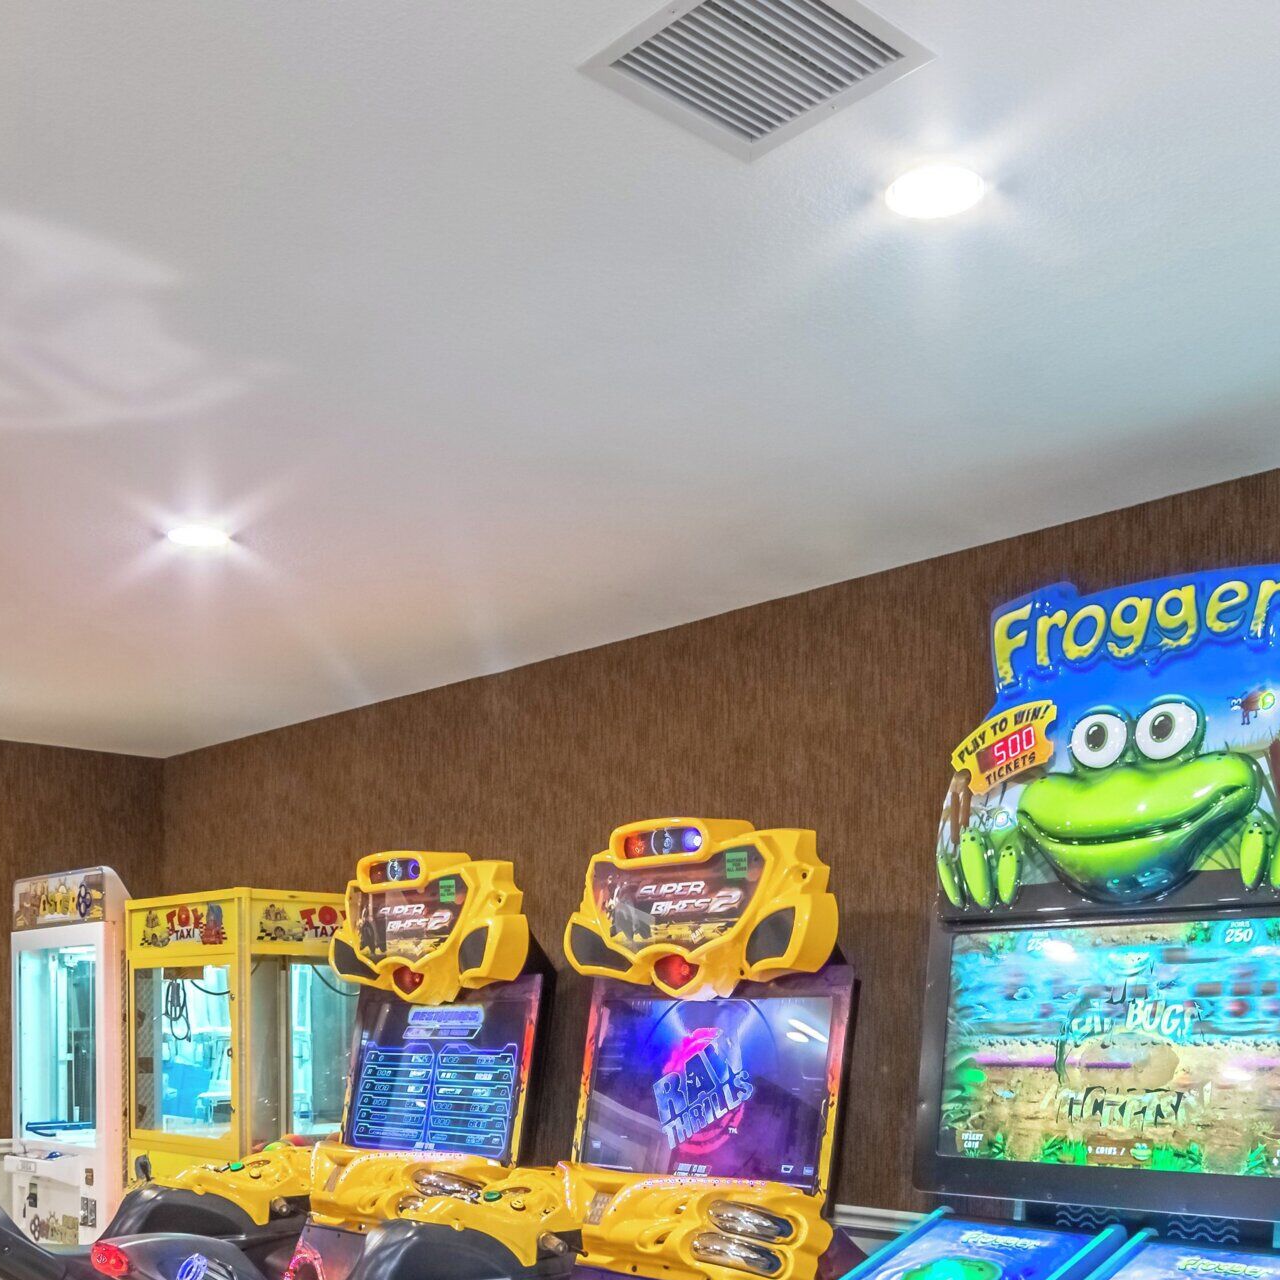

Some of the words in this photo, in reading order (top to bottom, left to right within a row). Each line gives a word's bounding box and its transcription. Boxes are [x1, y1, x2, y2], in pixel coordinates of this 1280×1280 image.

[958, 731, 986, 764] PLAY
[991, 717, 1008, 736] TO
[1014, 704, 1050, 726] WIN!
[994, 726, 1035, 765] 500
[985, 751, 1036, 786] TICKETS
[638, 881, 705, 897] SUPER
[651, 899, 711, 916] BIKES
[709, 887, 742, 914] 2
[166, 905, 205, 931] TOY
[428, 910, 452, 930] 2
[175, 928, 195, 940] TAXI
[314, 926, 342, 937] TAX
[1224, 928, 1255, 944] 250
[653, 1034, 743, 1125] RAW
[661, 1071, 754, 1150] THRILLS
[959, 1229, 1042, 1250] Frogger
[1176, 1254, 1273, 1279] Frogger
